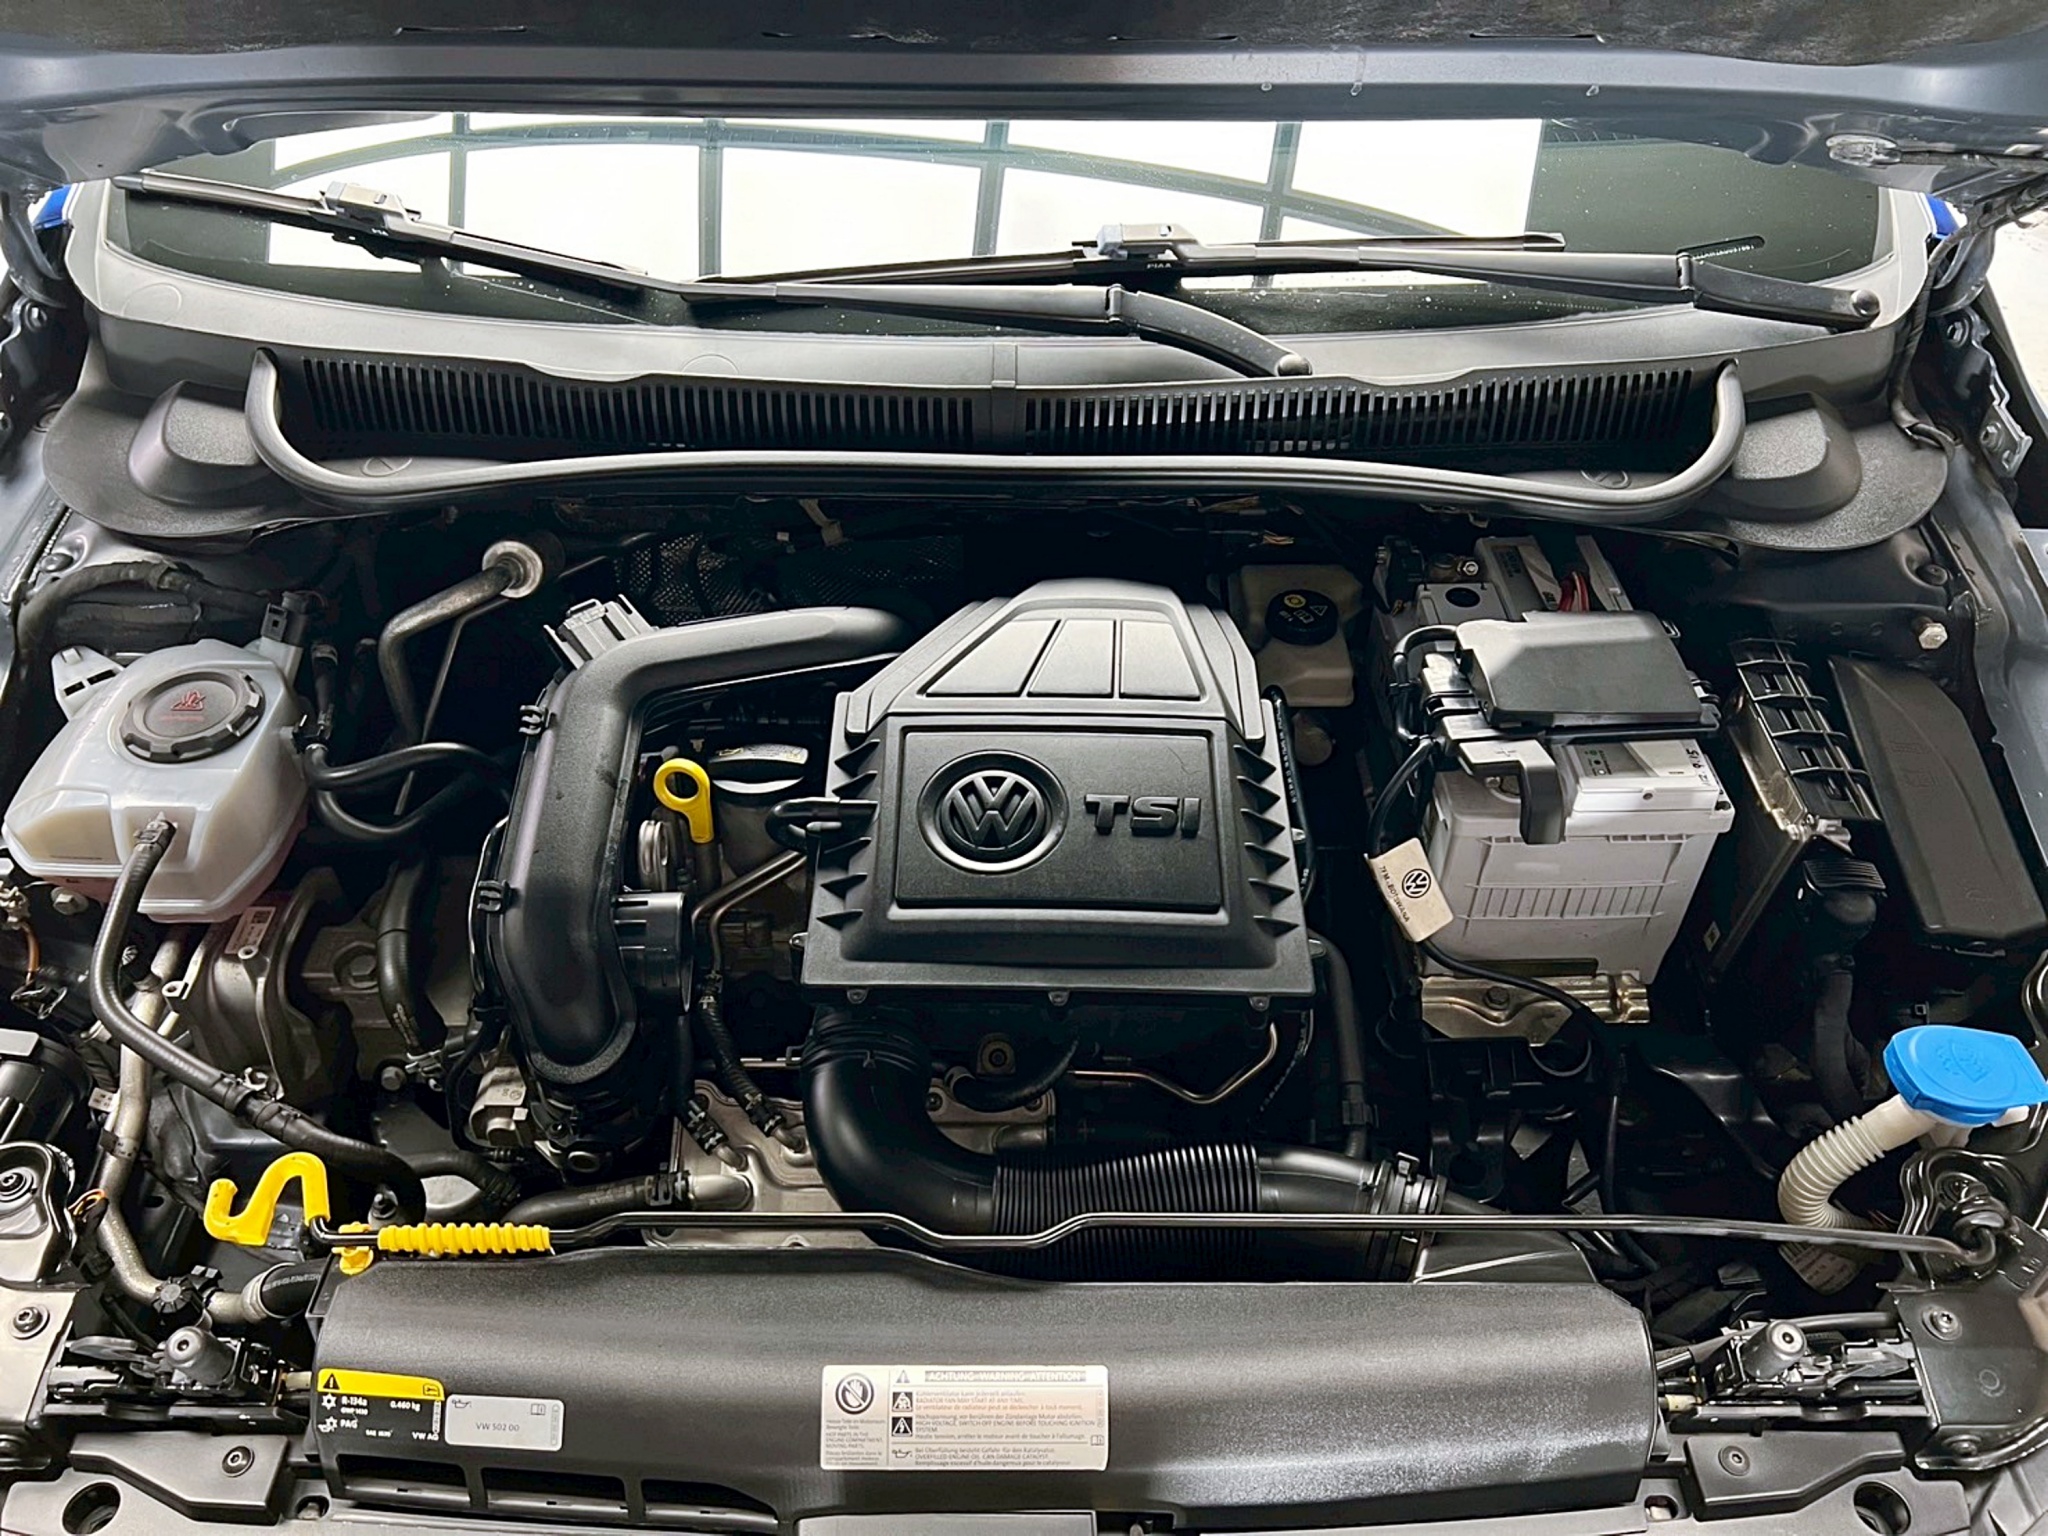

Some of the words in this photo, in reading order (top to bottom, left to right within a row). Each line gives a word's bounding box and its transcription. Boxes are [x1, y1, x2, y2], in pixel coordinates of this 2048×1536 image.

[1084, 793, 1201, 838] TSI
[929, 1371, 974, 1381] ACHTUNG
[979, 1371, 1024, 1381] WARNING
[1030, 1371, 1081, 1381] ATTENTION
[341, 1395, 368, 1407] R-134a
[340, 1419, 358, 1429] PAG
[475, 1422, 489, 1431] VW
[492, 1423, 506, 1431] 502
[508, 1423, 520, 1432] 00
[411, 1431, 426, 1440] VW
